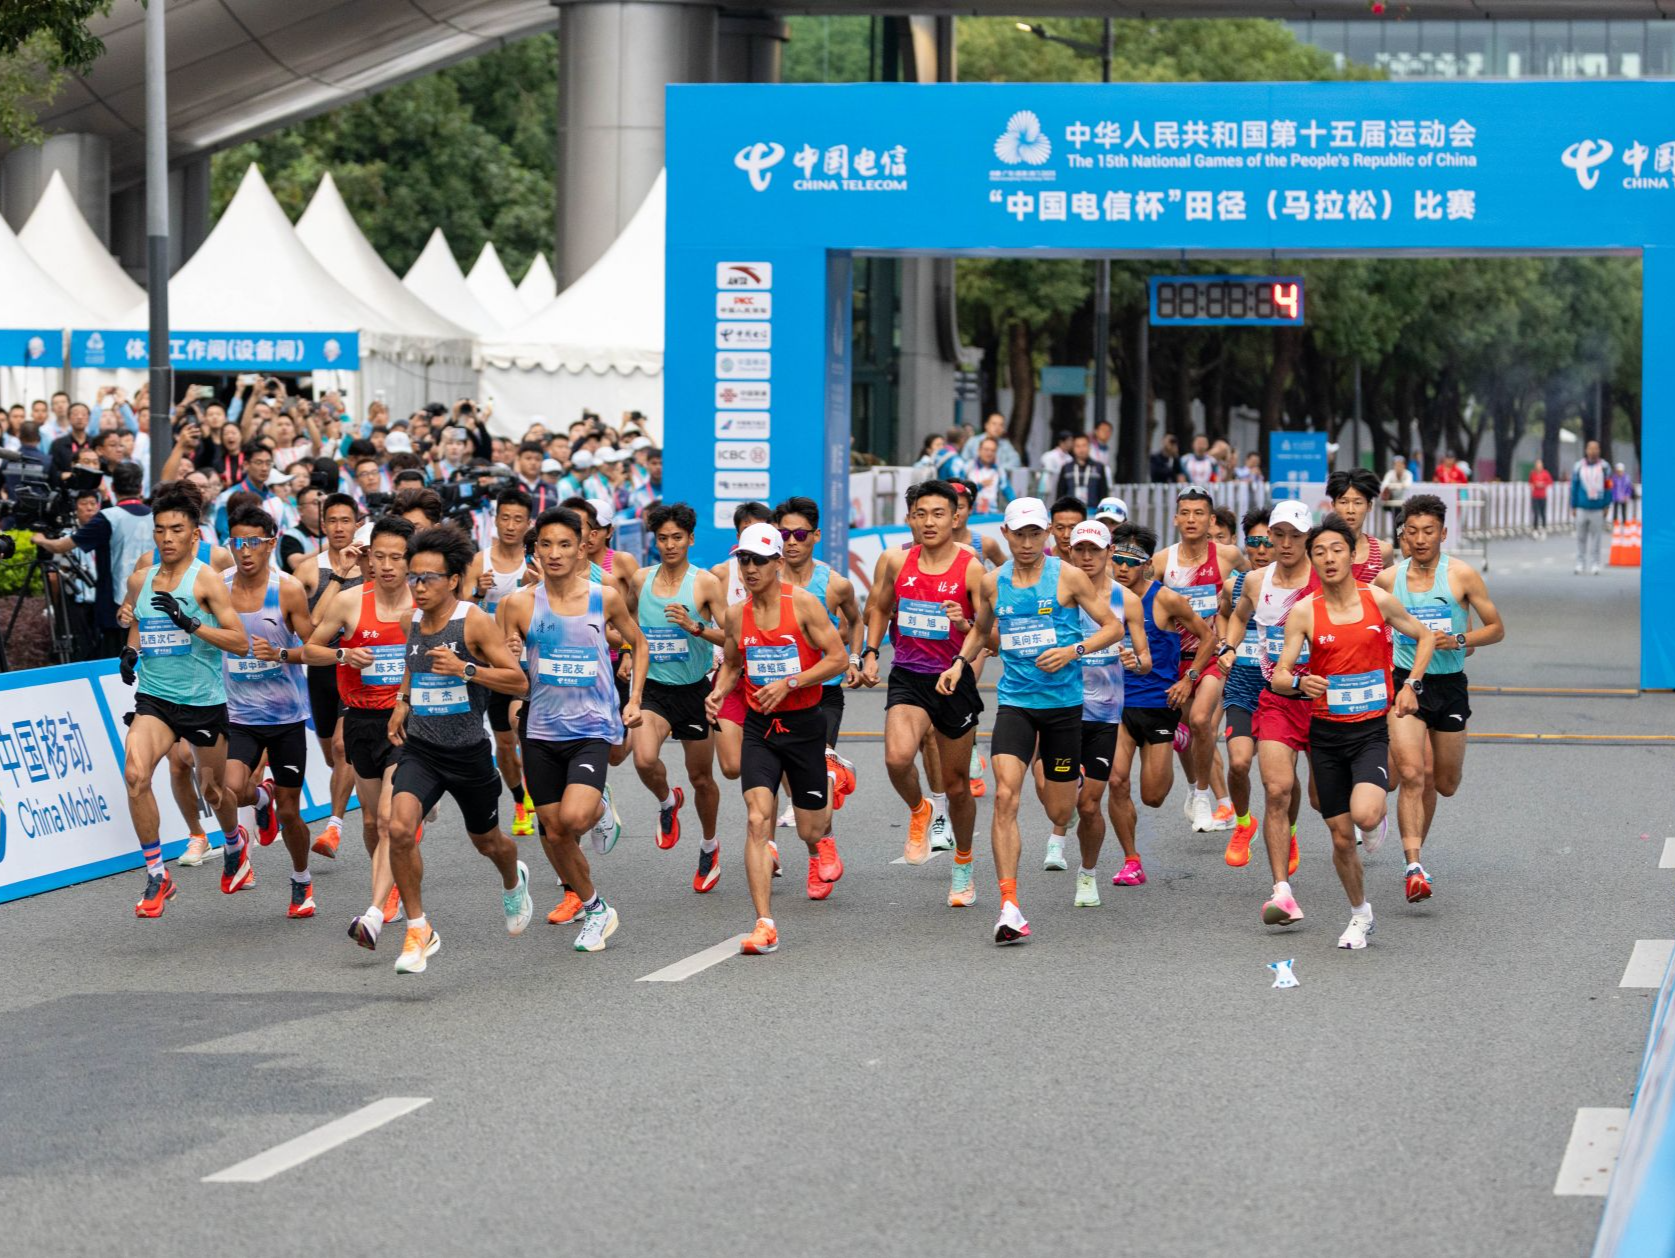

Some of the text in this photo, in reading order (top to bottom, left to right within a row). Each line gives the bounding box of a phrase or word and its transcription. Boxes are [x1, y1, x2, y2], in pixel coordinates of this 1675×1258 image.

[1065, 119, 1477, 150] 中华人民共和国第十五届运动会
[793, 143, 907, 179] 中国电信
[1067, 152, 1477, 170] The 15th National Games of the People's Republic of China
[793, 179, 907, 190] CHINA TELECOM
[1622, 177, 1669, 189] CHINA
[125, 338, 304, 361] 体工作间(设备间)
[718, 450, 746, 460] ICBC
[1076, 528, 1102, 536] CHINA
[0, 711, 93, 788] 中国移动
[18, 784, 111, 839] China Mobile
